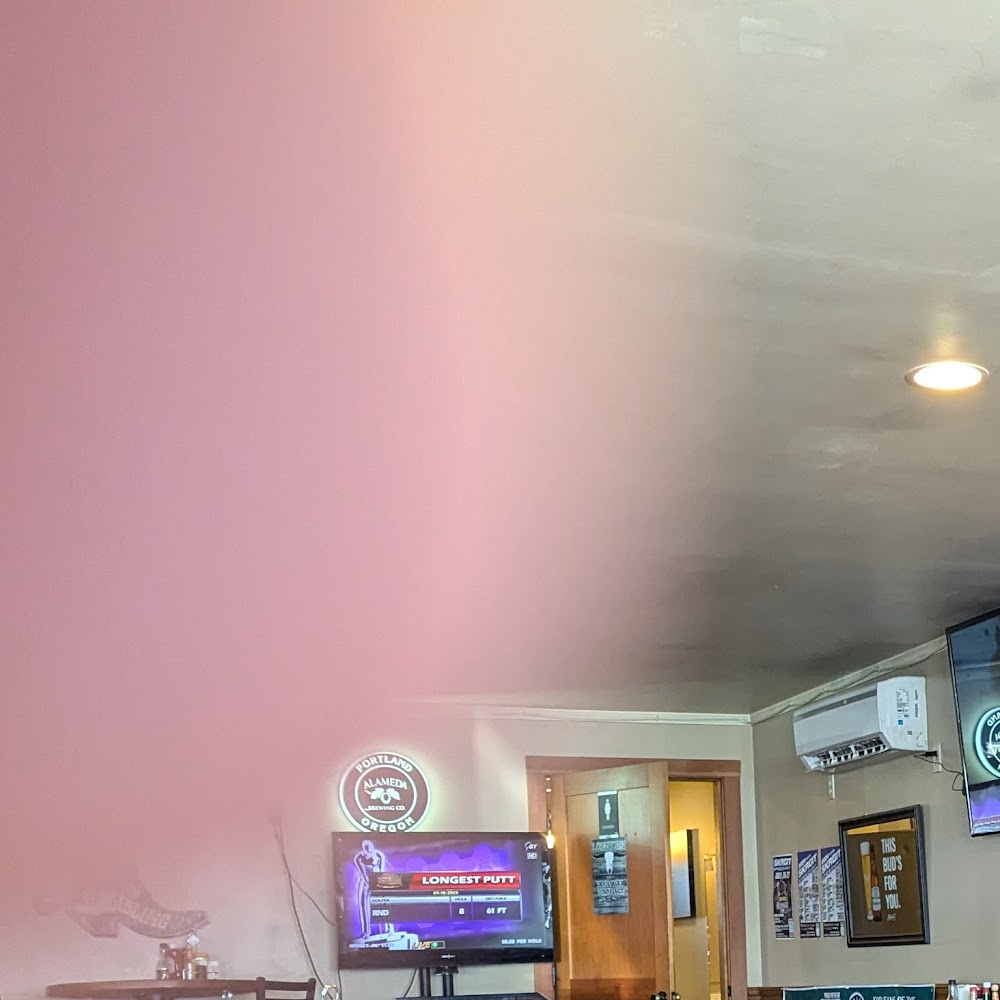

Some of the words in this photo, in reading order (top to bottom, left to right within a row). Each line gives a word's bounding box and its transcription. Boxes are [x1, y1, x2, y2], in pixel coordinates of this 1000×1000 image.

[355, 755, 413, 773] PORTLAND
[364, 777, 407, 789] ALAMEDA
[361, 817, 414, 832] OREGON
[881, 837, 896, 853] THIS
[882, 855, 902, 872] BUD'S
[422, 876, 480, 884] LONGEST
[483, 875, 516, 884] PUTT
[884, 875, 897, 891] FOR
[885, 893, 901, 909] YOU.
[372, 909, 390, 917] RND
